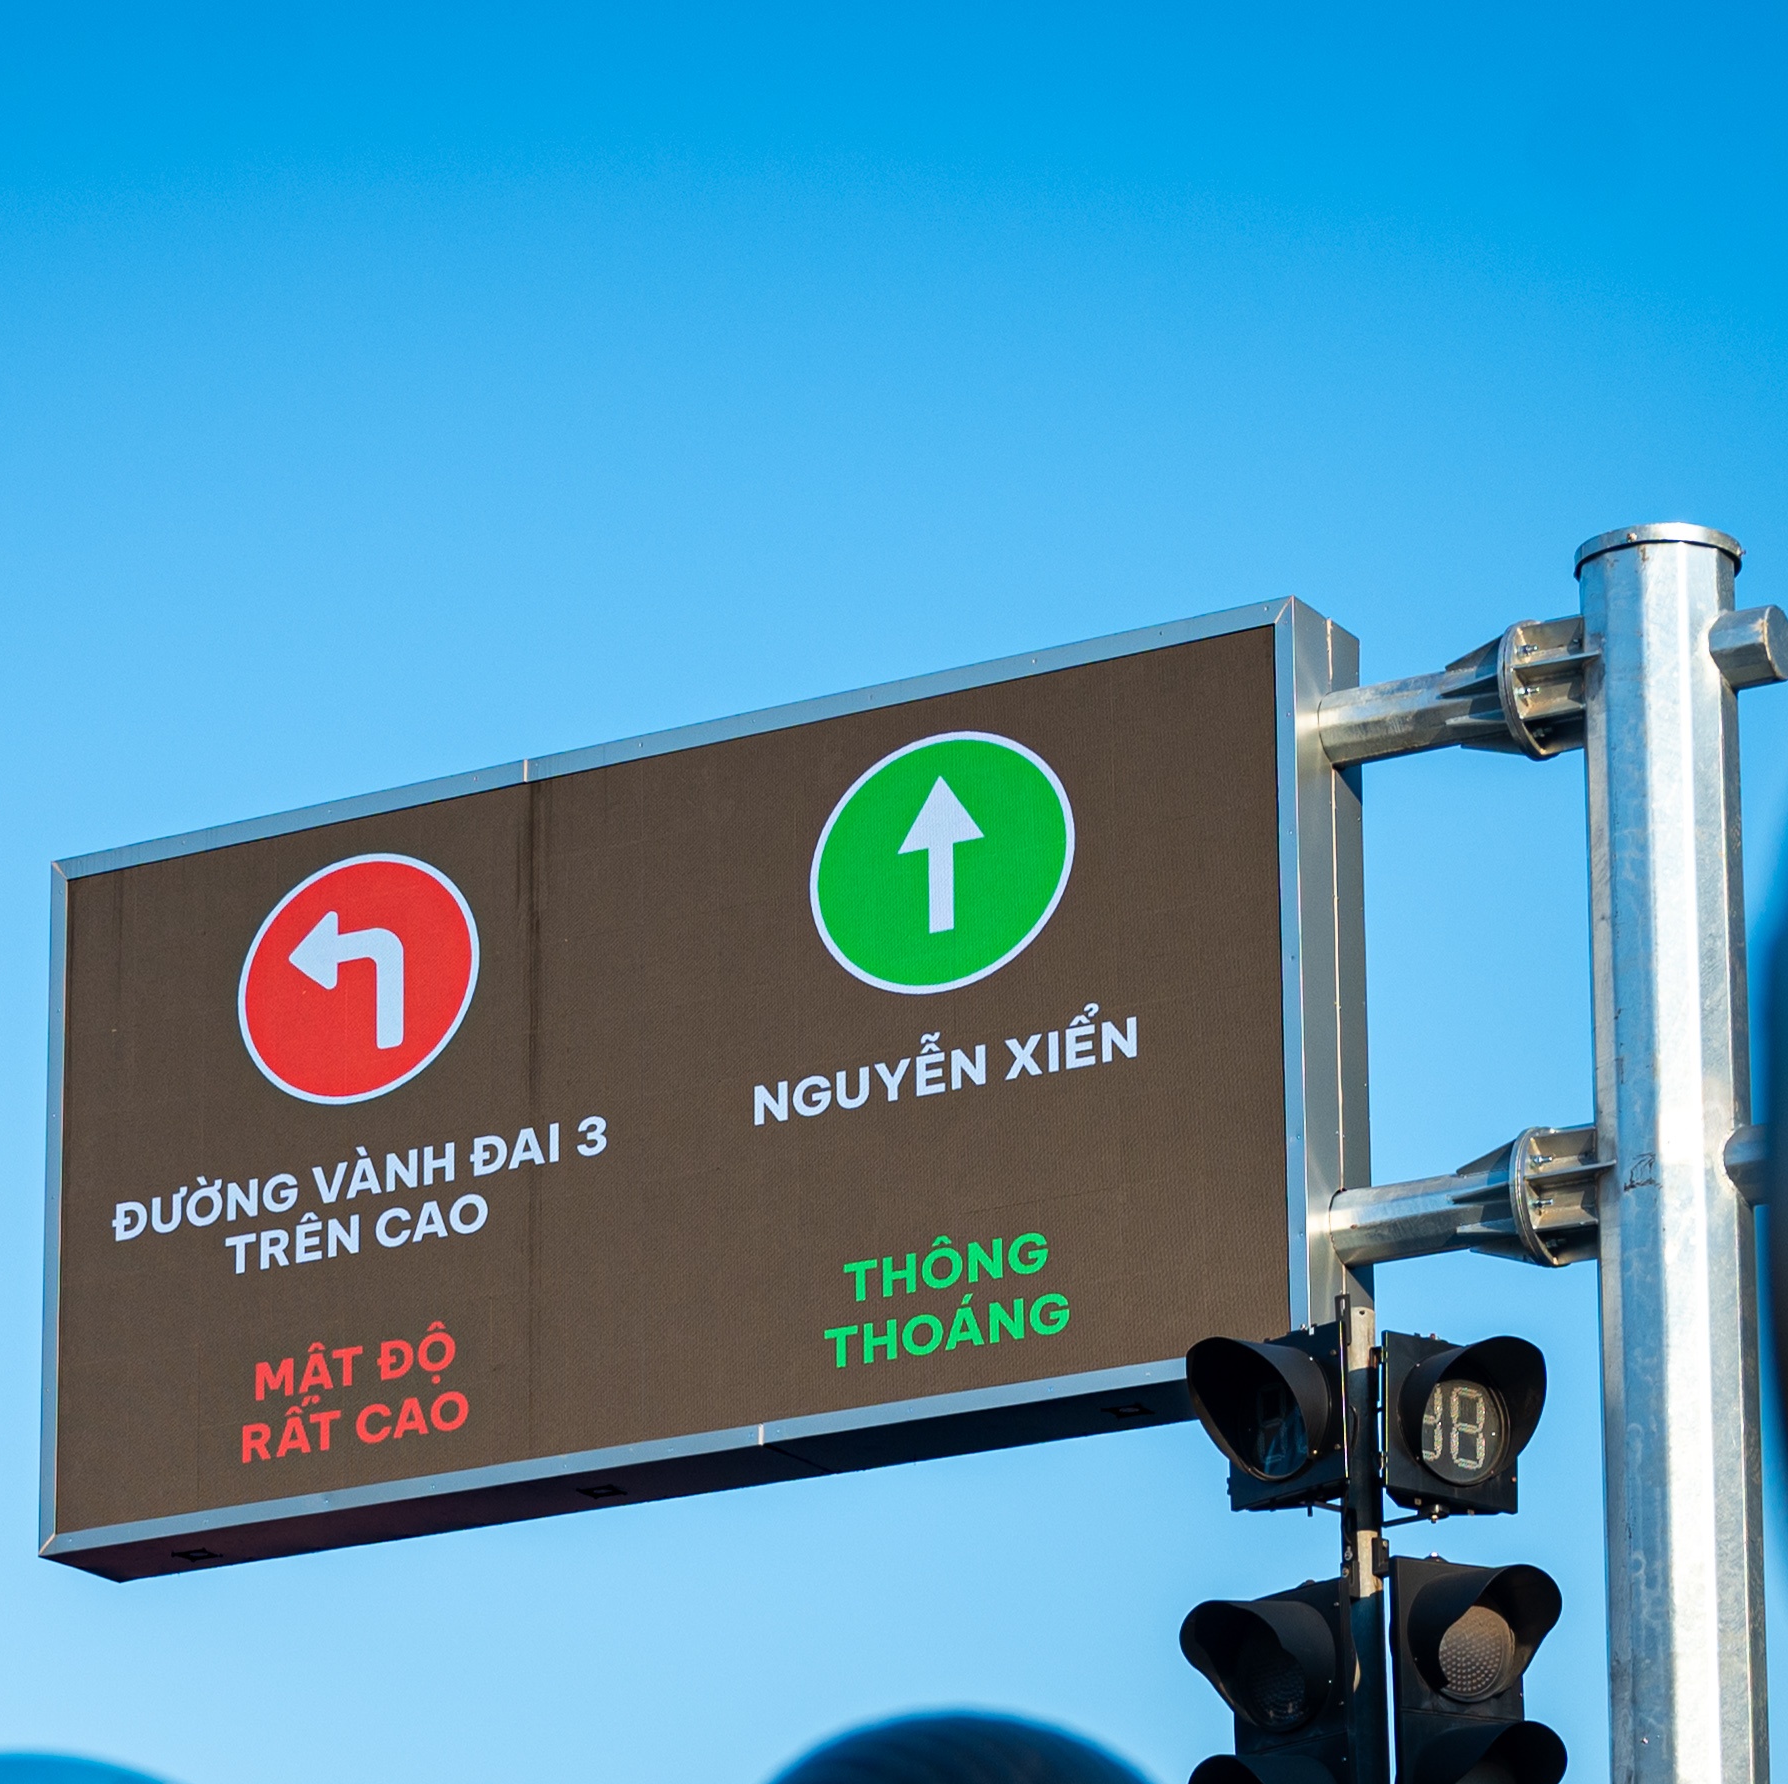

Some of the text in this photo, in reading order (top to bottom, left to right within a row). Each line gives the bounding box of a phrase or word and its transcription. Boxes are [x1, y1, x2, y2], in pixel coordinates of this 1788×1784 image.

[753, 1002, 1138, 1127] NGUYỄN XIỂN
[111, 1115, 608, 1243] ĐƯỜNG VÀNH ĐAI 3
[225, 1193, 490, 1275] TRÊN CAO
[842, 1232, 1049, 1302] THÔNG
[255, 1321, 457, 1405] MẬT ĐỘ
[824, 1292, 1071, 1369] THOÁNG
[241, 1391, 470, 1464] RẤT CAO
